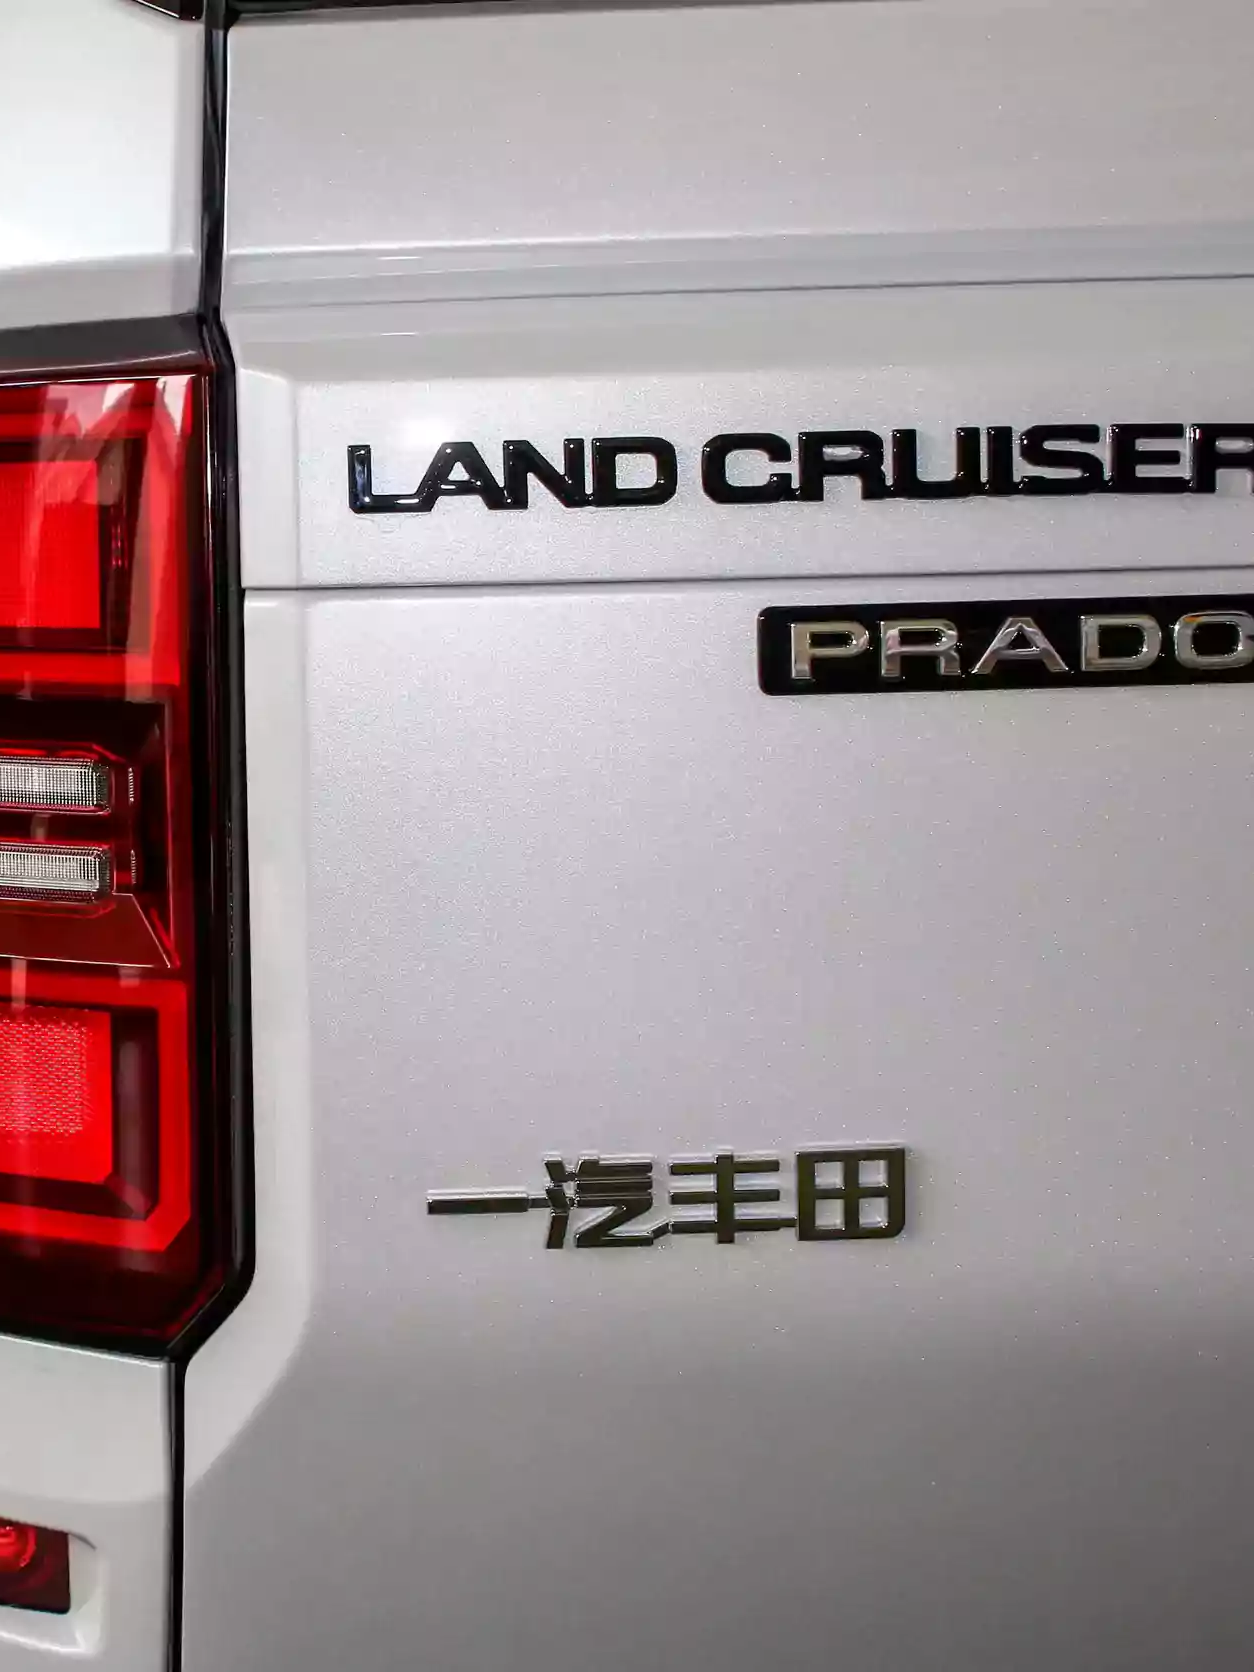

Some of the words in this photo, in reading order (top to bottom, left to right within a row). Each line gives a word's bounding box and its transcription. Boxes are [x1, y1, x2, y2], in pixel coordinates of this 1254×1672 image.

[347, 436, 678, 514] LAND
[701, 424, 1254, 502] CRUISER
[789, 611, 1254, 680] PRADO
[427, 1142, 906, 1249] 一汽丰田
